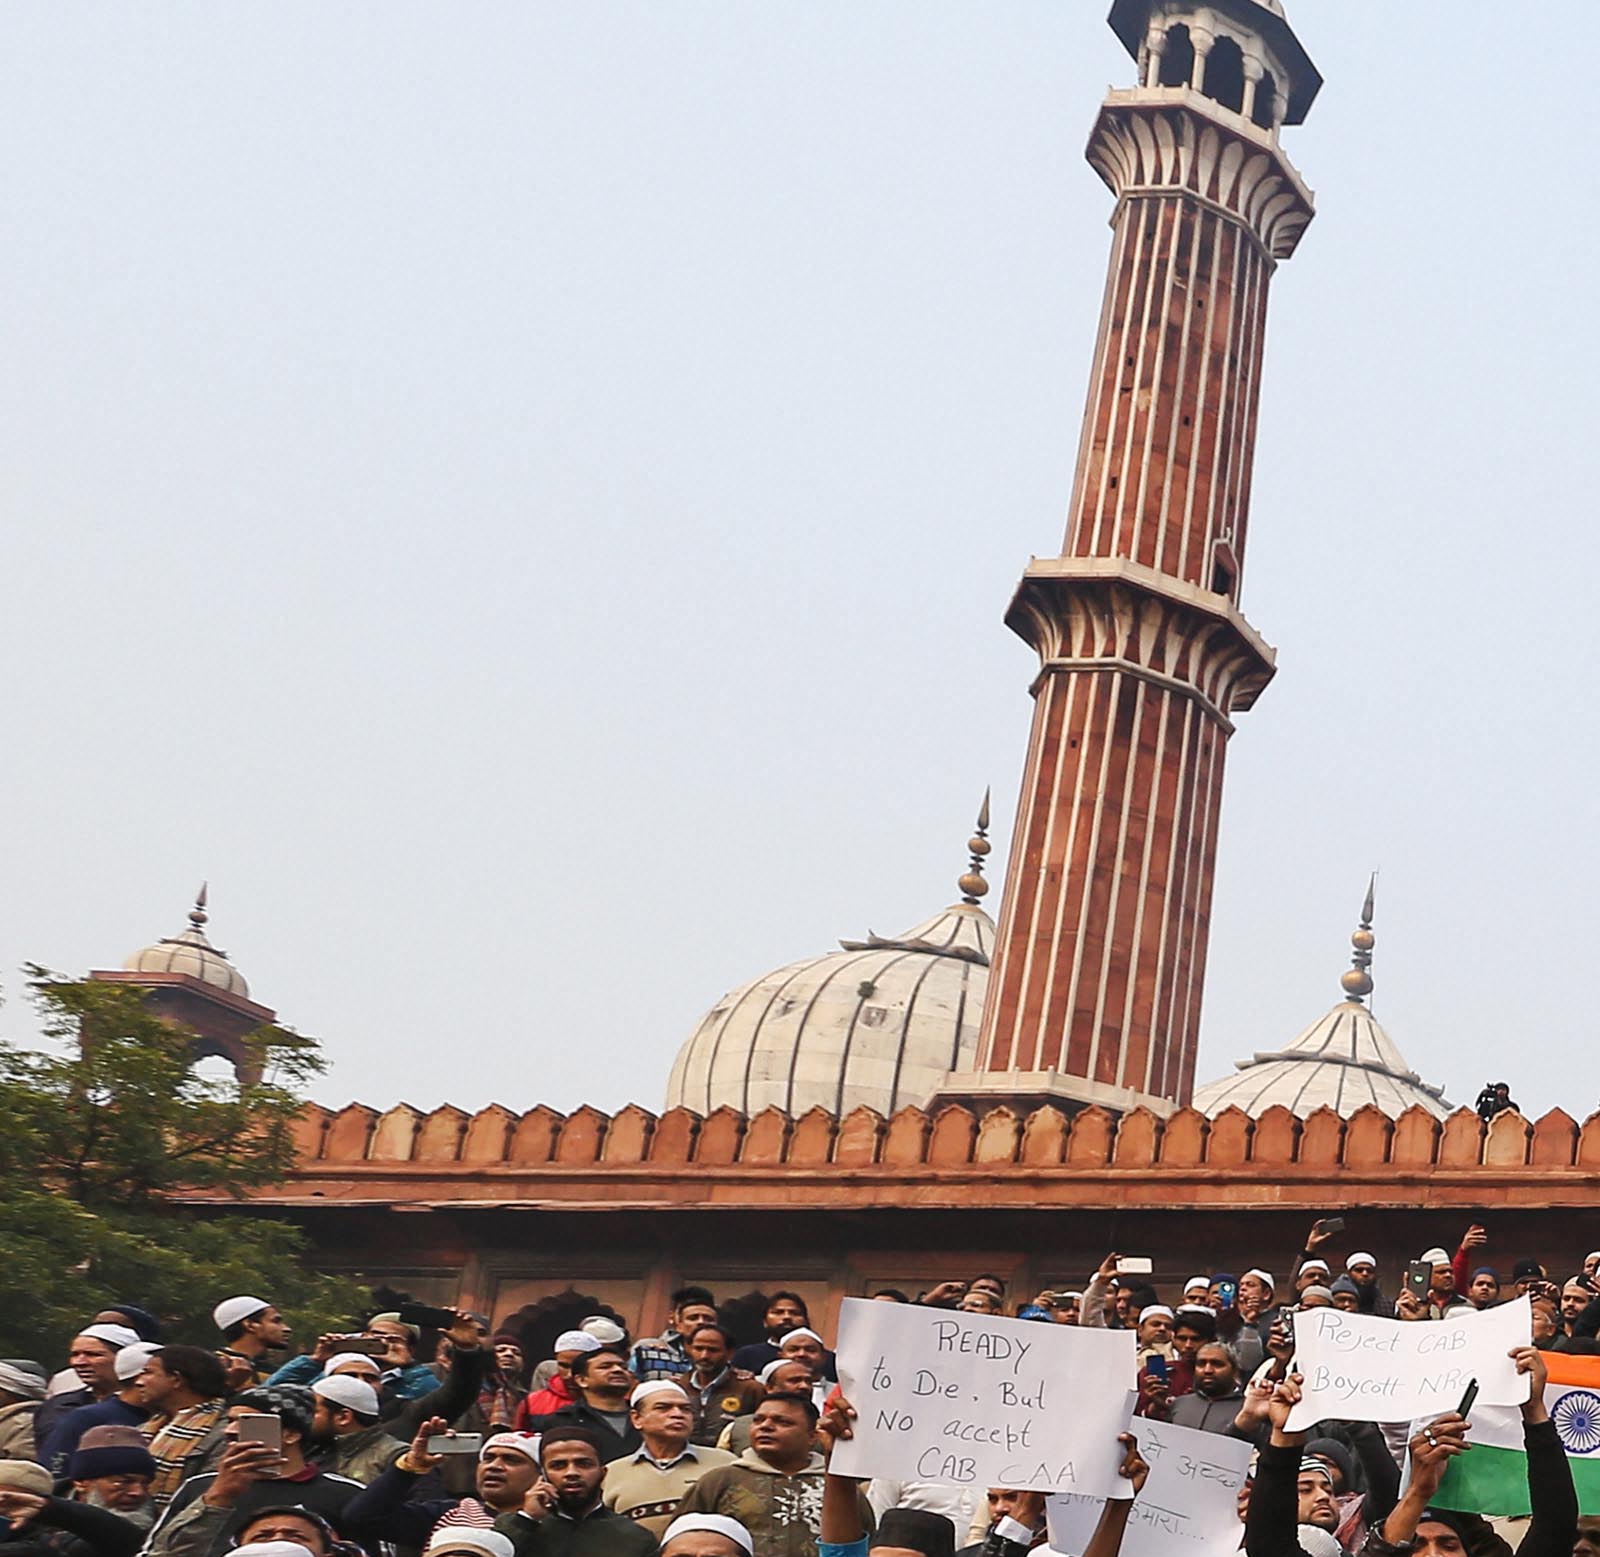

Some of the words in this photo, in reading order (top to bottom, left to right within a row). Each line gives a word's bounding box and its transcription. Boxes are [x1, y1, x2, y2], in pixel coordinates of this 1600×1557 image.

[932, 1320, 1032, 1374] READY
[1316, 1312, 1400, 1352] Reject
[1417, 1329, 1467, 1354] CAB
[871, 1356, 892, 1390] to
[999, 1379, 1046, 1410] But
[1312, 1366, 1406, 1400] Boycott
[943, 1419, 1032, 1451] accept
[917, 1447, 977, 1482] CAB
[998, 1461, 1076, 1484] CAA
